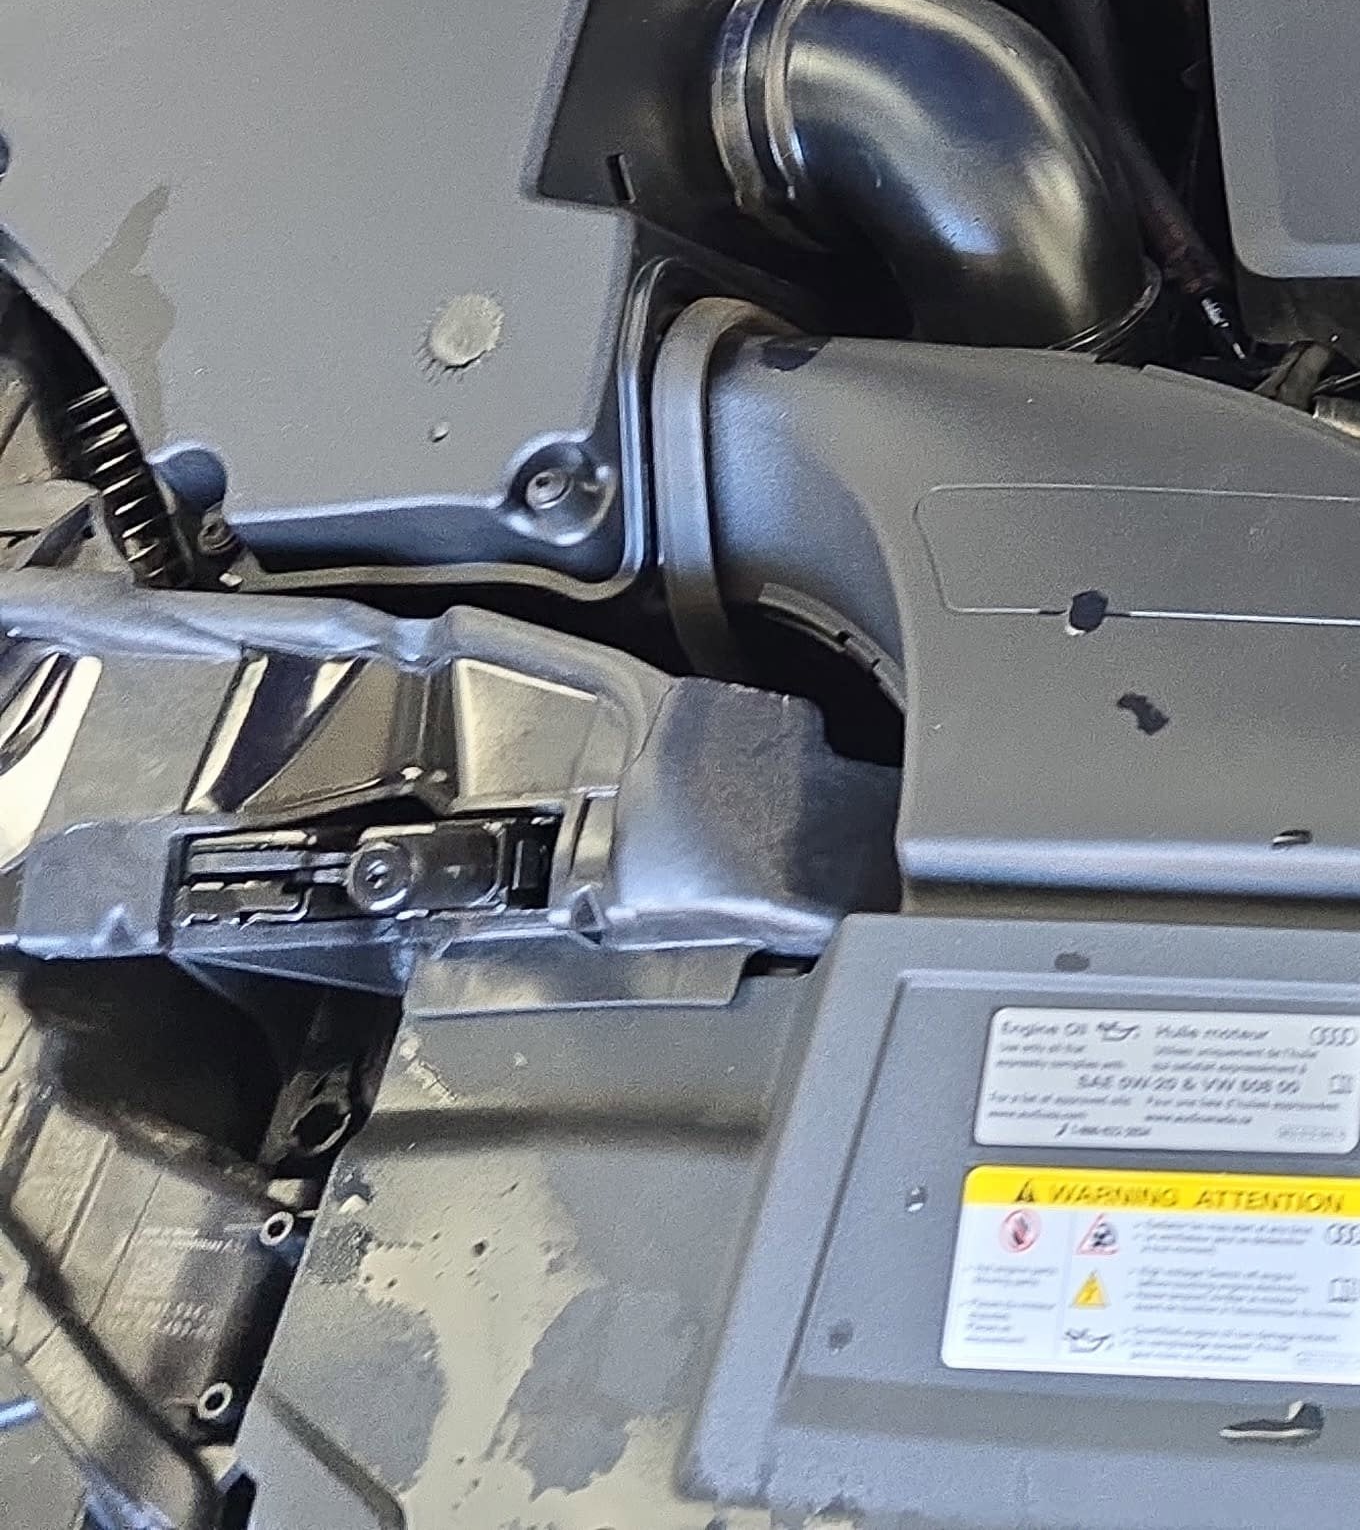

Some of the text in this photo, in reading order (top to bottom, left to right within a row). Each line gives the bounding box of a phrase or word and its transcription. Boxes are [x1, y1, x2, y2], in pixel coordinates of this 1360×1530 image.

[1078, 1073, 1114, 1090] SAE
[1203, 1076, 1237, 1092] VW
[1051, 1184, 1346, 1214] WARNING ATTENTION
